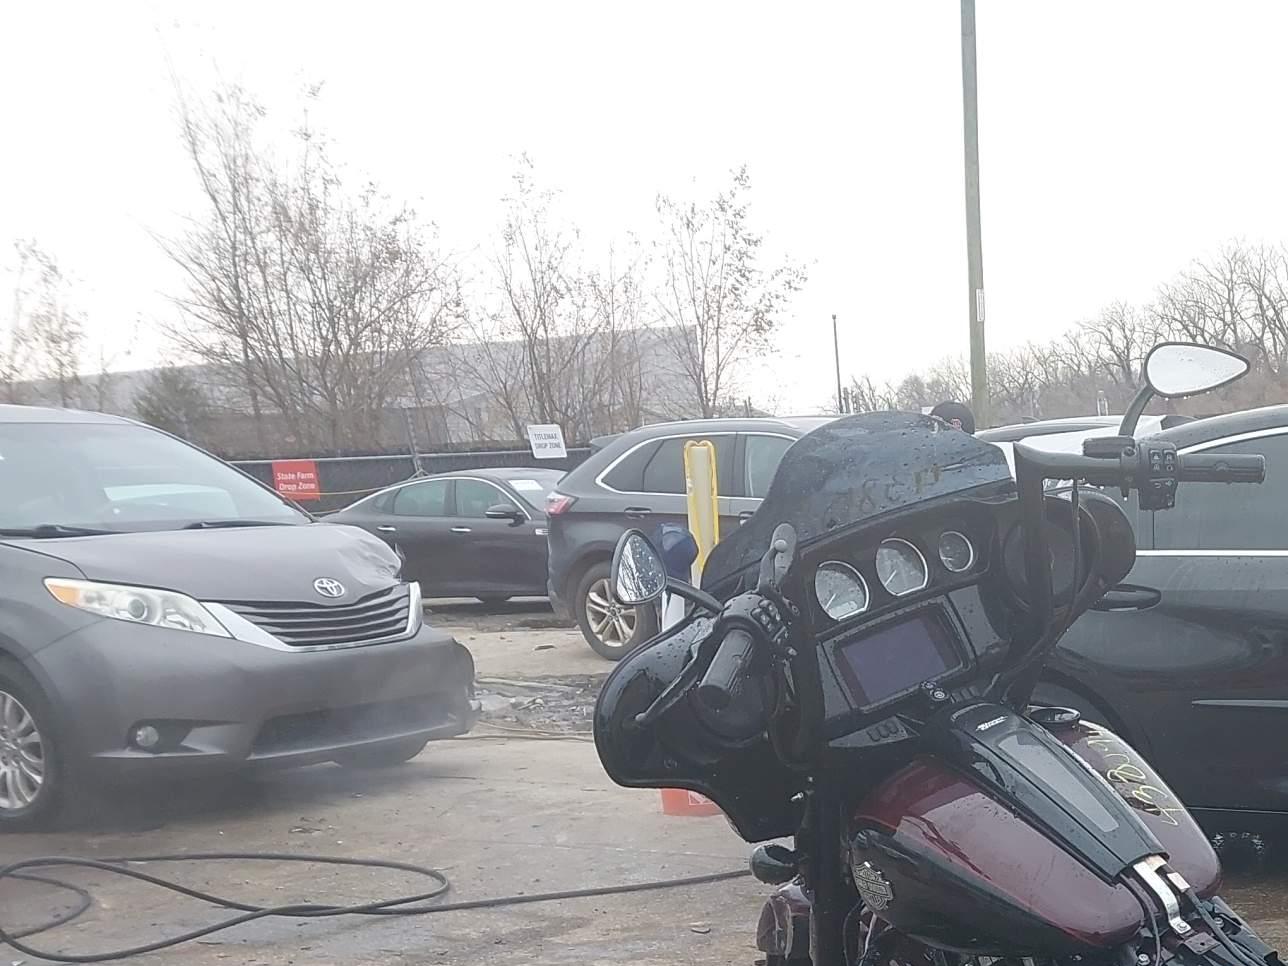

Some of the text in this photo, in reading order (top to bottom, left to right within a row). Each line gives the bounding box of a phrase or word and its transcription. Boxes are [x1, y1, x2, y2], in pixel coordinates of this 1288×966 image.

[276, 471, 314, 481] State Farm
[279, 482, 316, 492] Drop Zone
